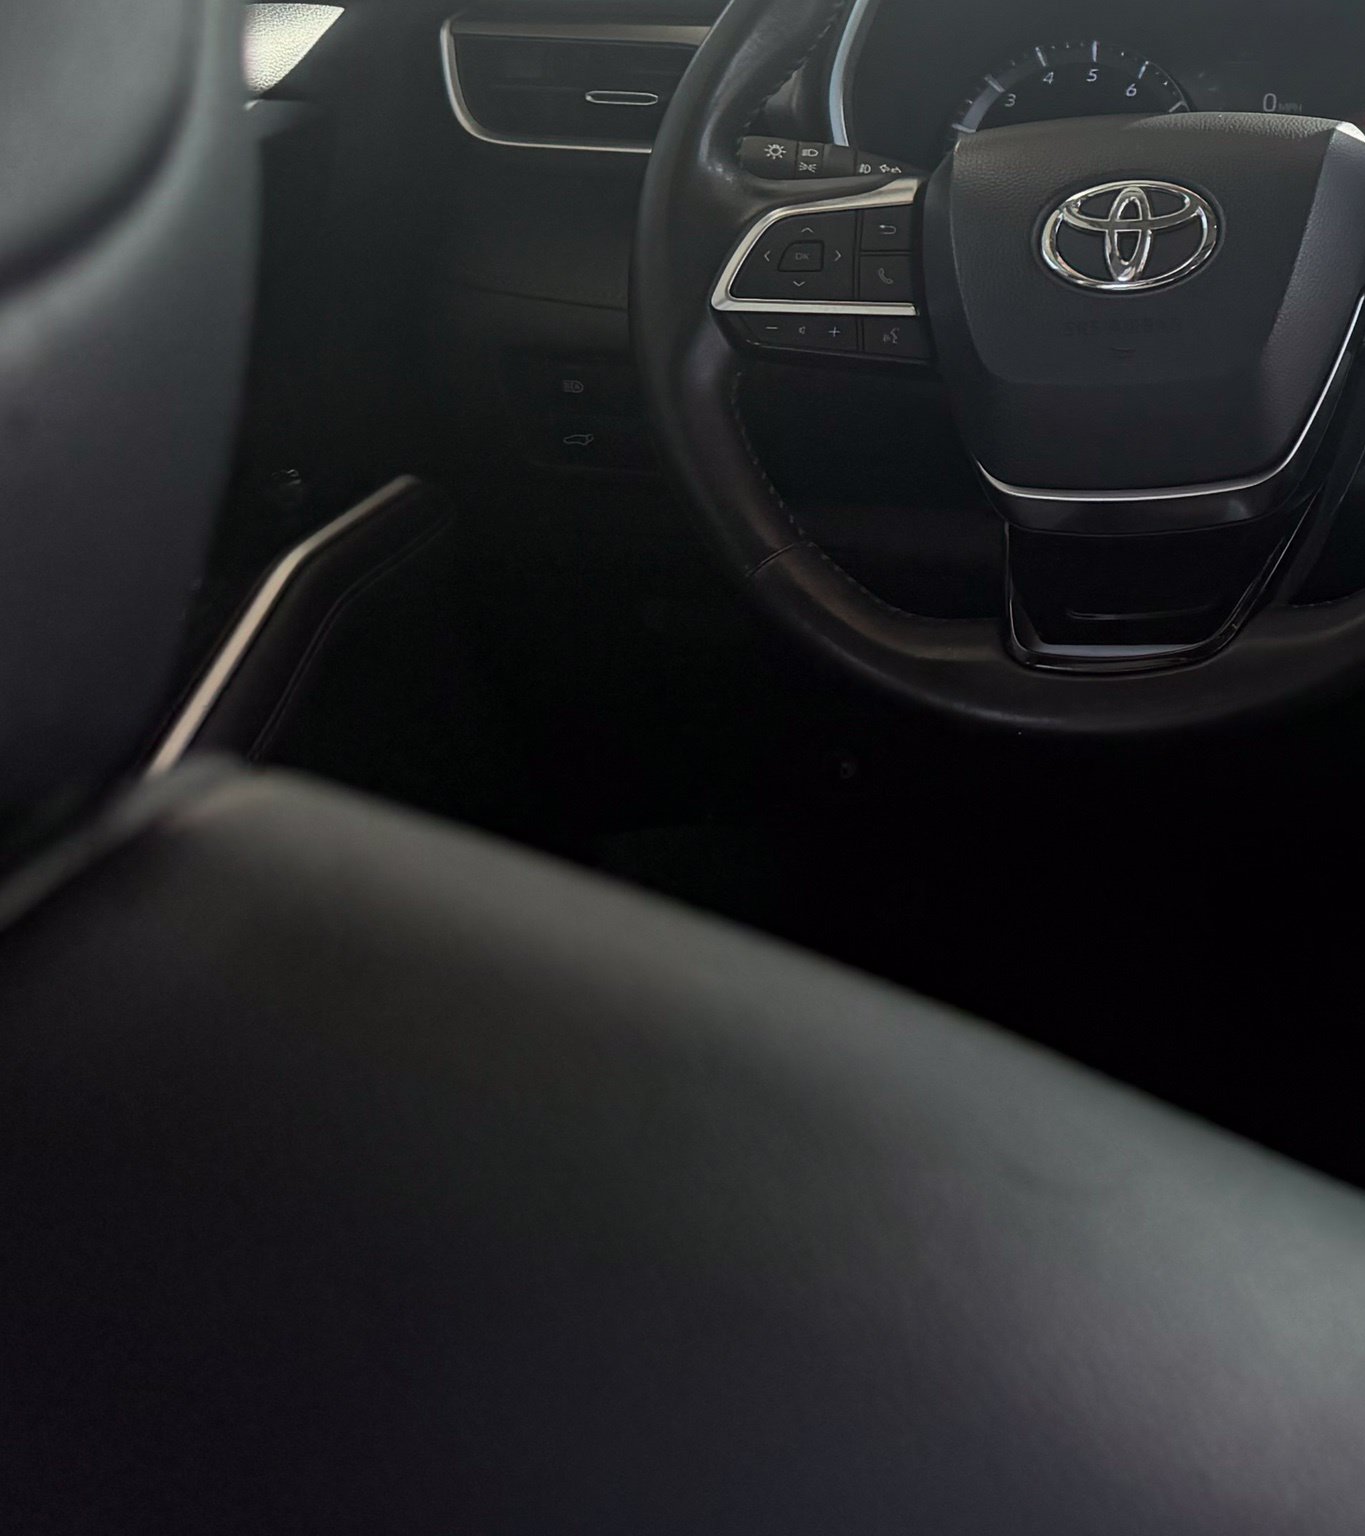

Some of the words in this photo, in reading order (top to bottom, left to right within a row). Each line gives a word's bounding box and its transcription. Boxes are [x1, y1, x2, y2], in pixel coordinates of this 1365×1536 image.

[1042, 71, 1055, 86] 4
[1085, 68, 1100, 83] 5
[1125, 83, 1138, 98] 6
[1004, 92, 1017, 107] 3
[1262, 92, 1278, 112] 0
